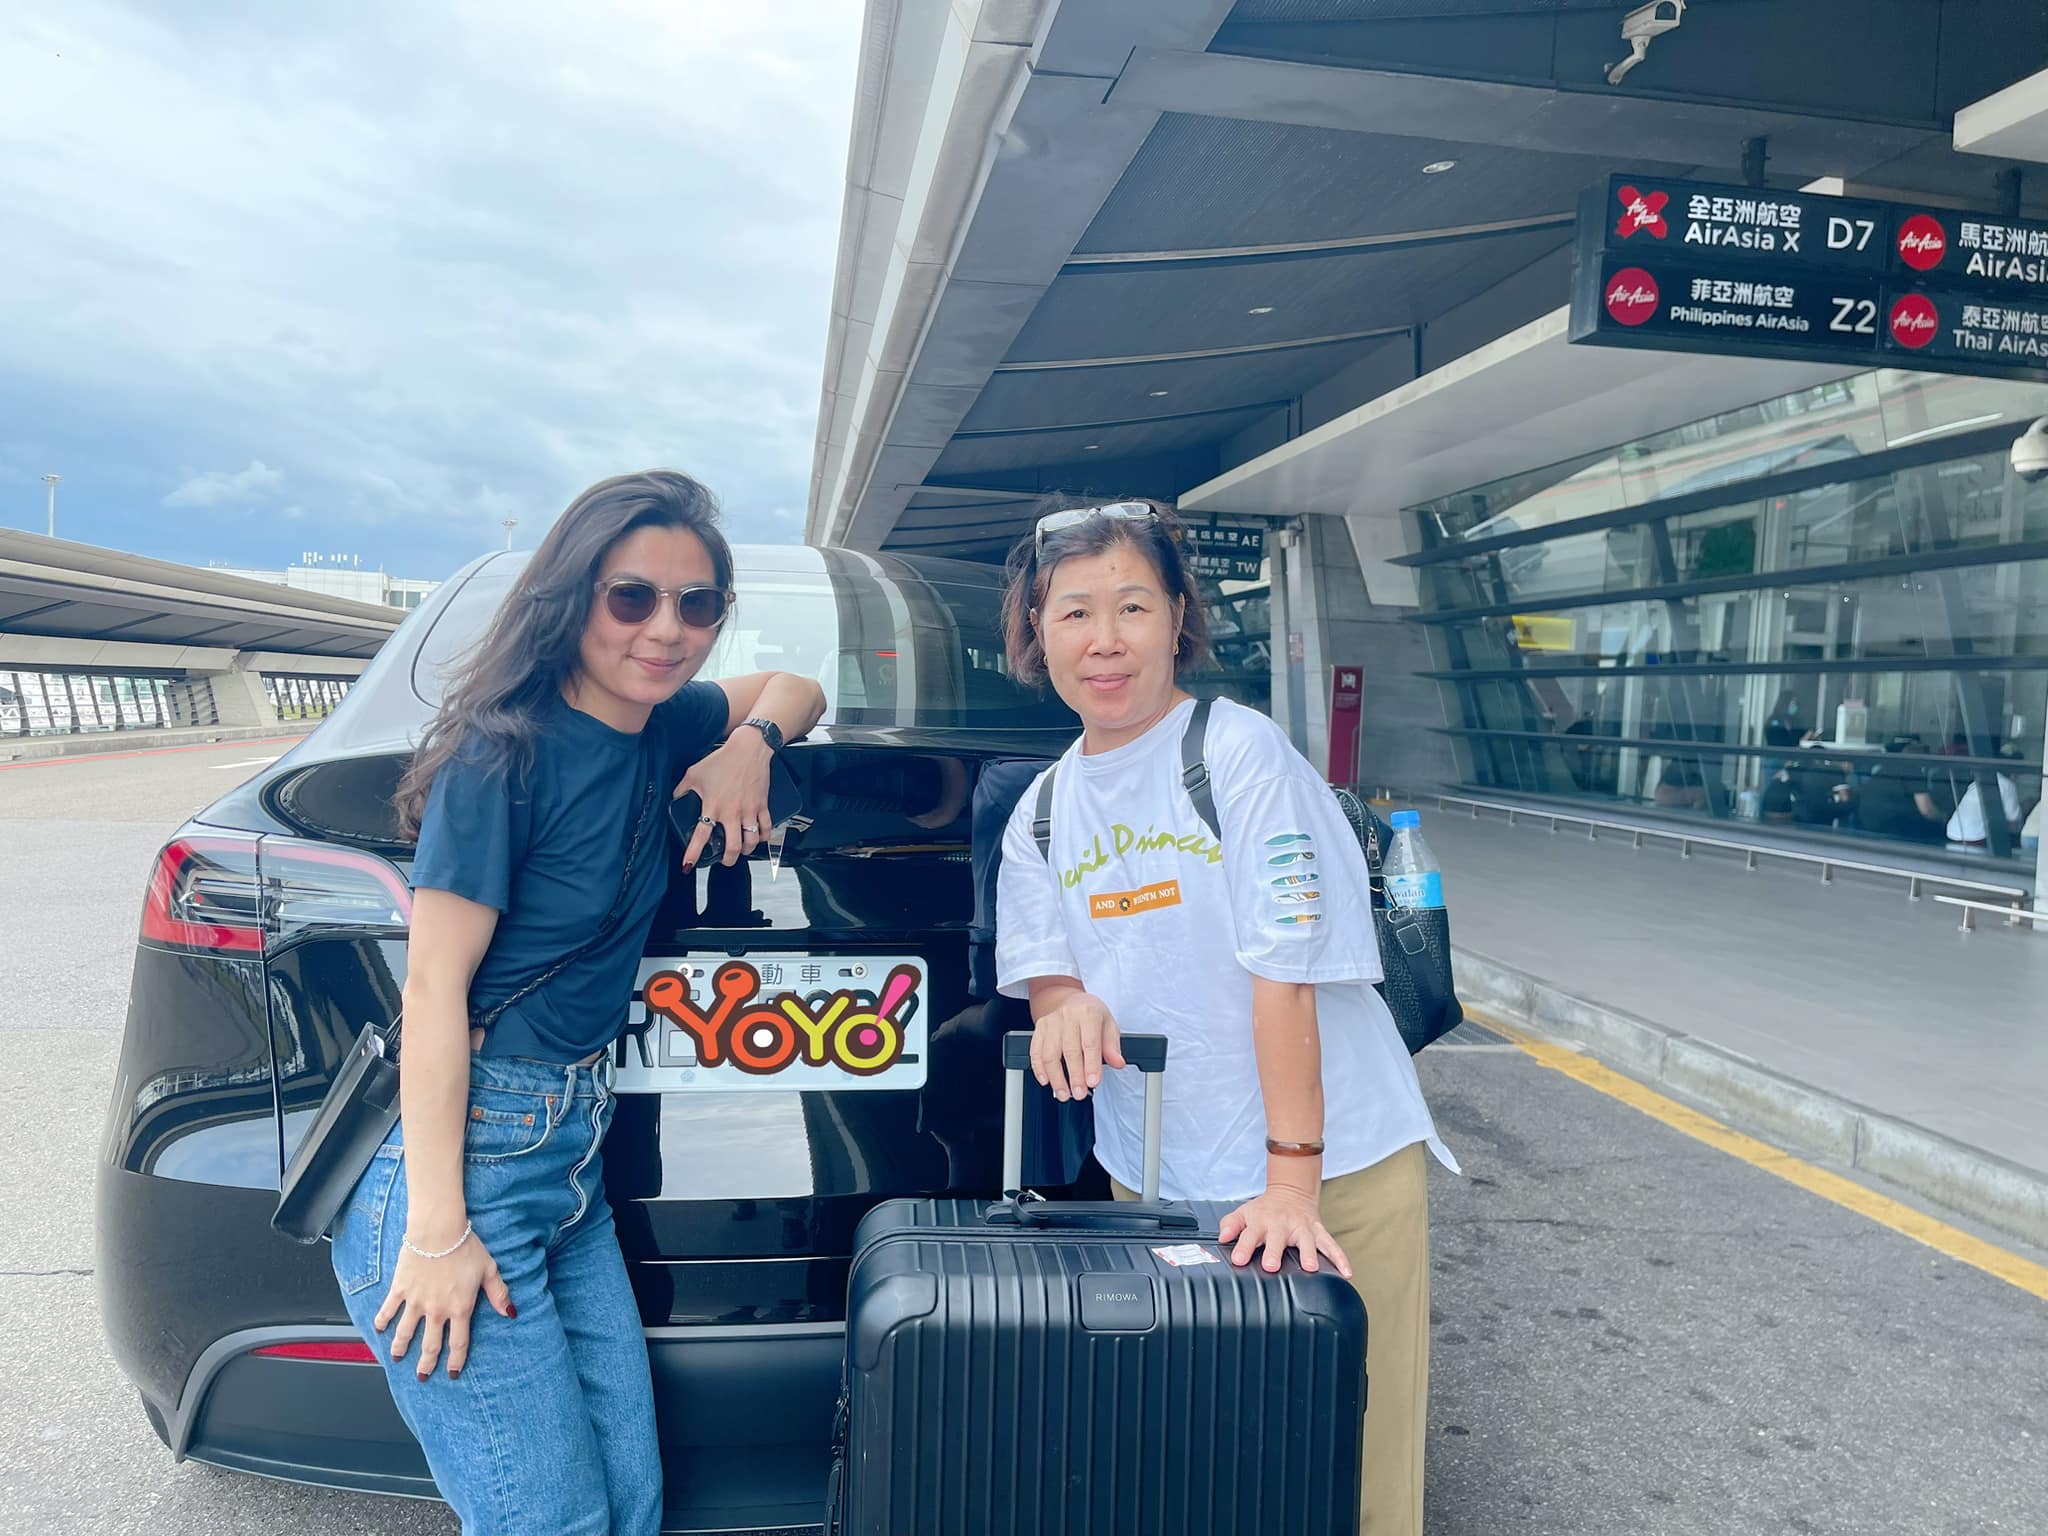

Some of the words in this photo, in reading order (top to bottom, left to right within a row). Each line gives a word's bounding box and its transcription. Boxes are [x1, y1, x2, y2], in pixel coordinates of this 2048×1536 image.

[1687, 194, 1802, 229] 全亞洲航空
[1684, 221, 1775, 251] AirAsia
[1782, 231, 1801, 252] X
[1827, 216, 1875, 251] D7
[1958, 222, 2048, 257] 馬亞洲航
[1965, 252, 2048, 283] AirAsi
[1691, 278, 1795, 308] 菲亞洲航空
[1670, 305, 1753, 327] Philippines
[1755, 314, 1810, 332] AirAsia
[1829, 297, 1877, 334] Z2
[1953, 329, 1993, 351] Thai
[1241, 535, 1260, 547] AE
[1236, 562, 1259, 574] TW
[1095, 899, 1116, 911] AND
[1158, 887, 1176, 899] NOT
[1095, 1292, 1139, 1302] RIMOWA
